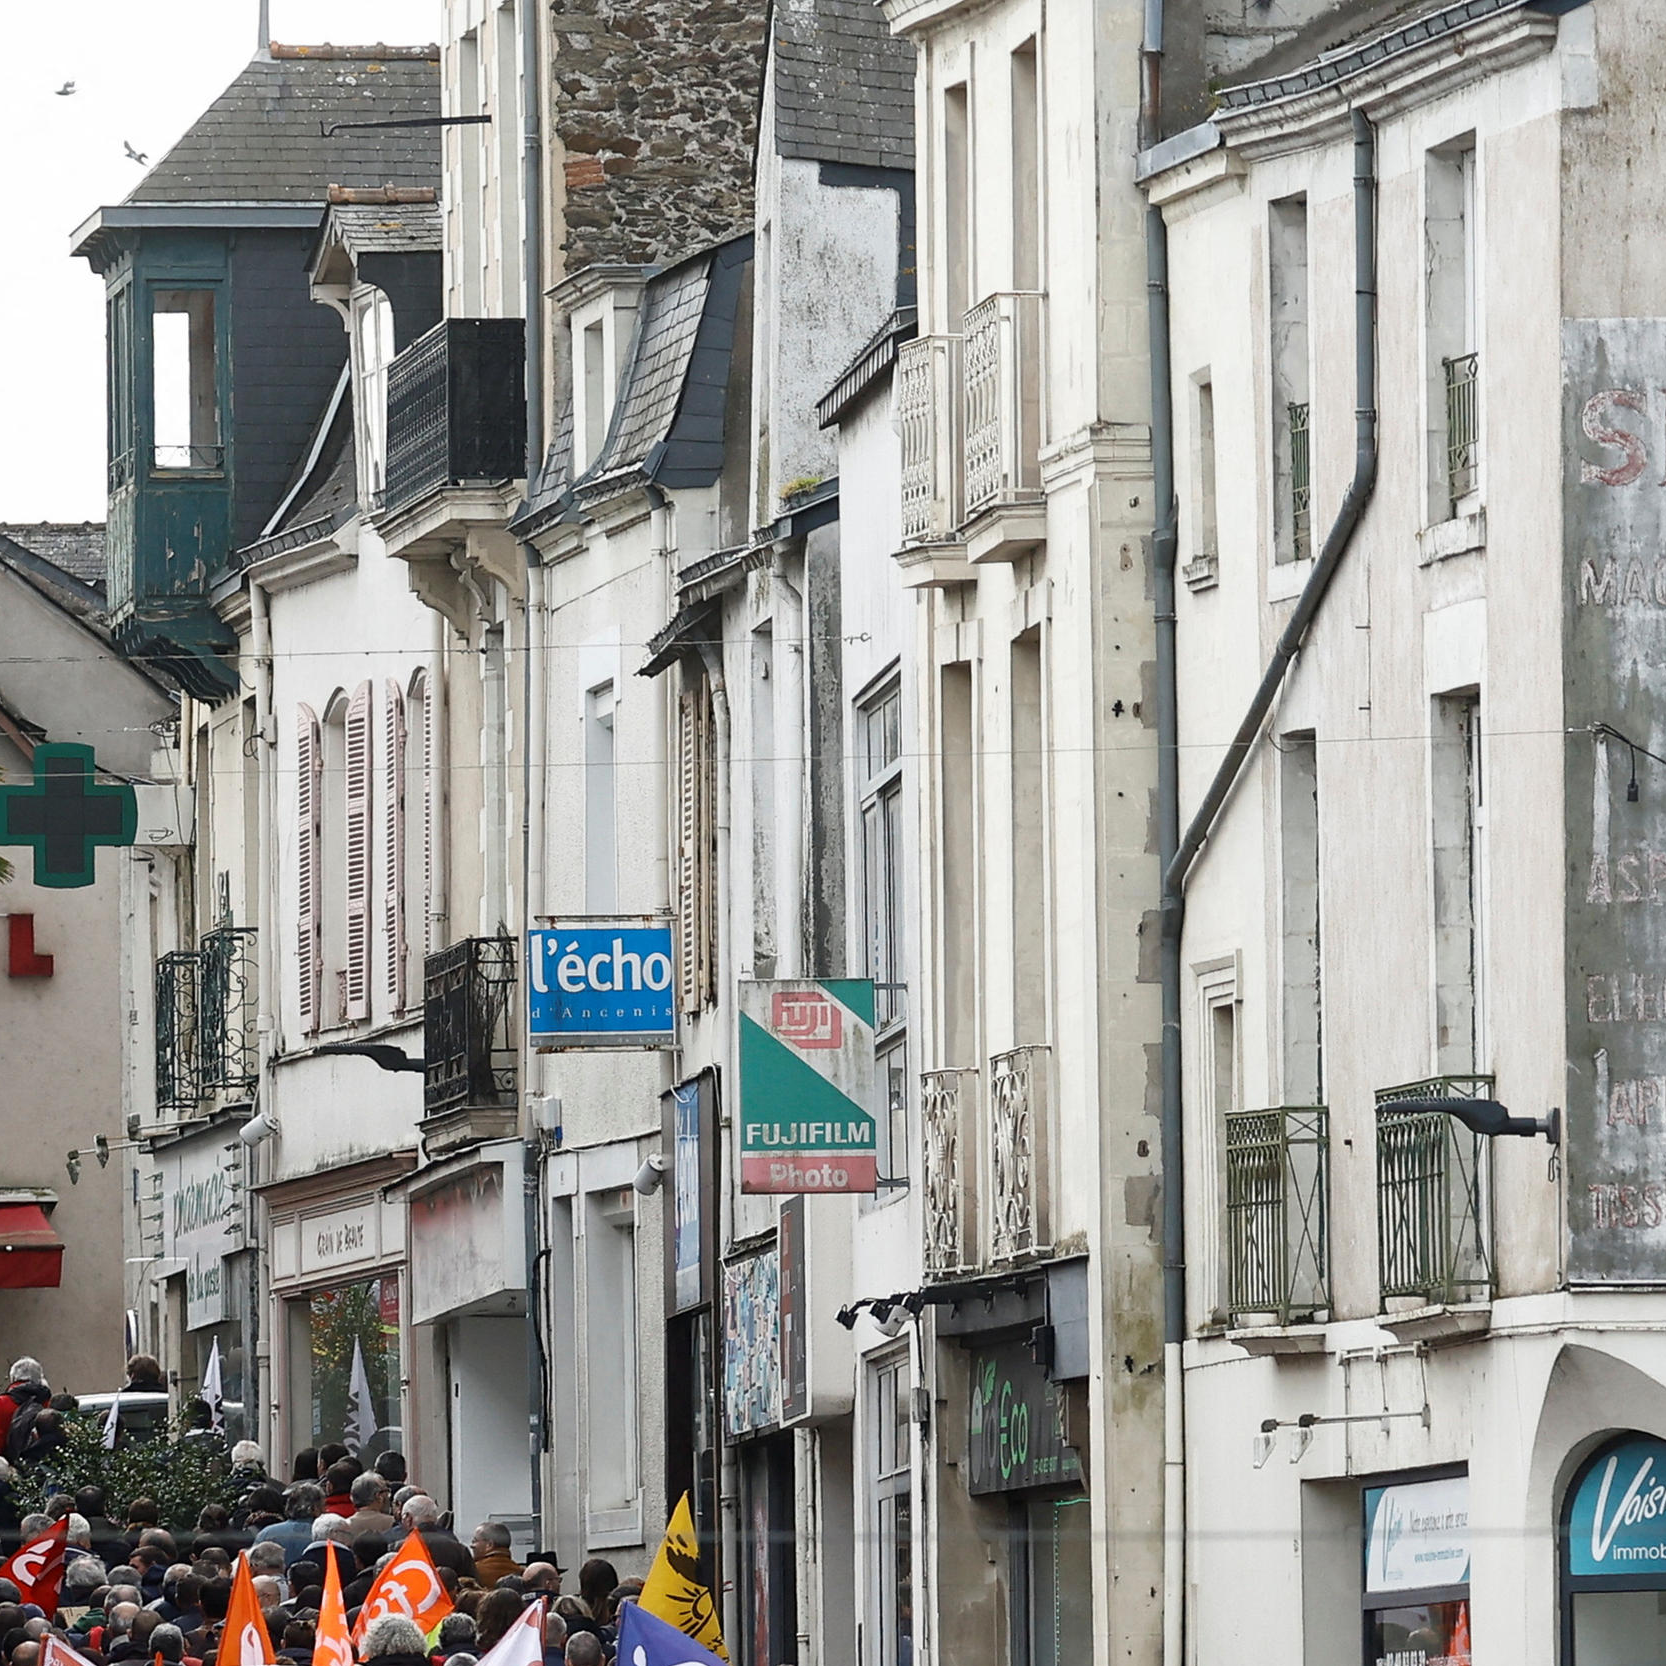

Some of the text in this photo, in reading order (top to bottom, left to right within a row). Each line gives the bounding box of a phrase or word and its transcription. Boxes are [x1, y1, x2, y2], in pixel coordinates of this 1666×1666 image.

[530, 933, 672, 994] l'écho
[746, 1121, 870, 1145] FUJIFILM
[769, 1163, 848, 1188] Photo
